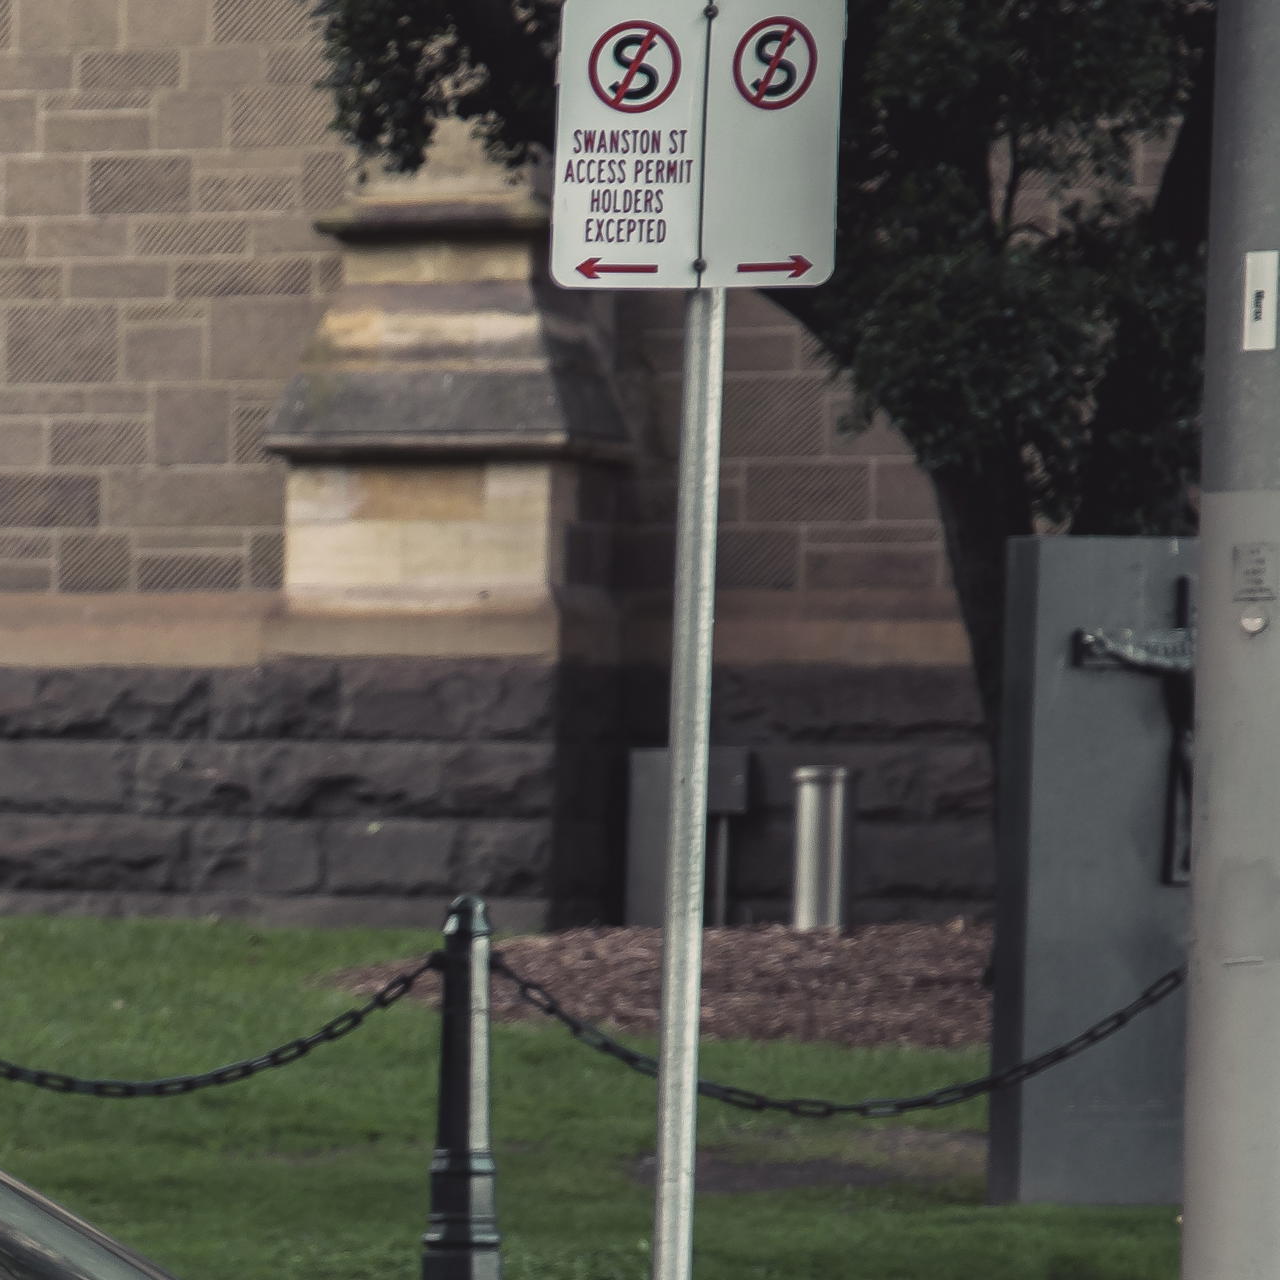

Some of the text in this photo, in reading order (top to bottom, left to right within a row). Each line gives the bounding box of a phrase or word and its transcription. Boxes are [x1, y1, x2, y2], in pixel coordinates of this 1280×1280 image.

[572, 129, 688, 154] SWANSTON ST
[563, 159, 694, 184] ACCESS PERMIT
[589, 189, 664, 214] HOLDERS
[584, 218, 667, 243] EXCEPTED
